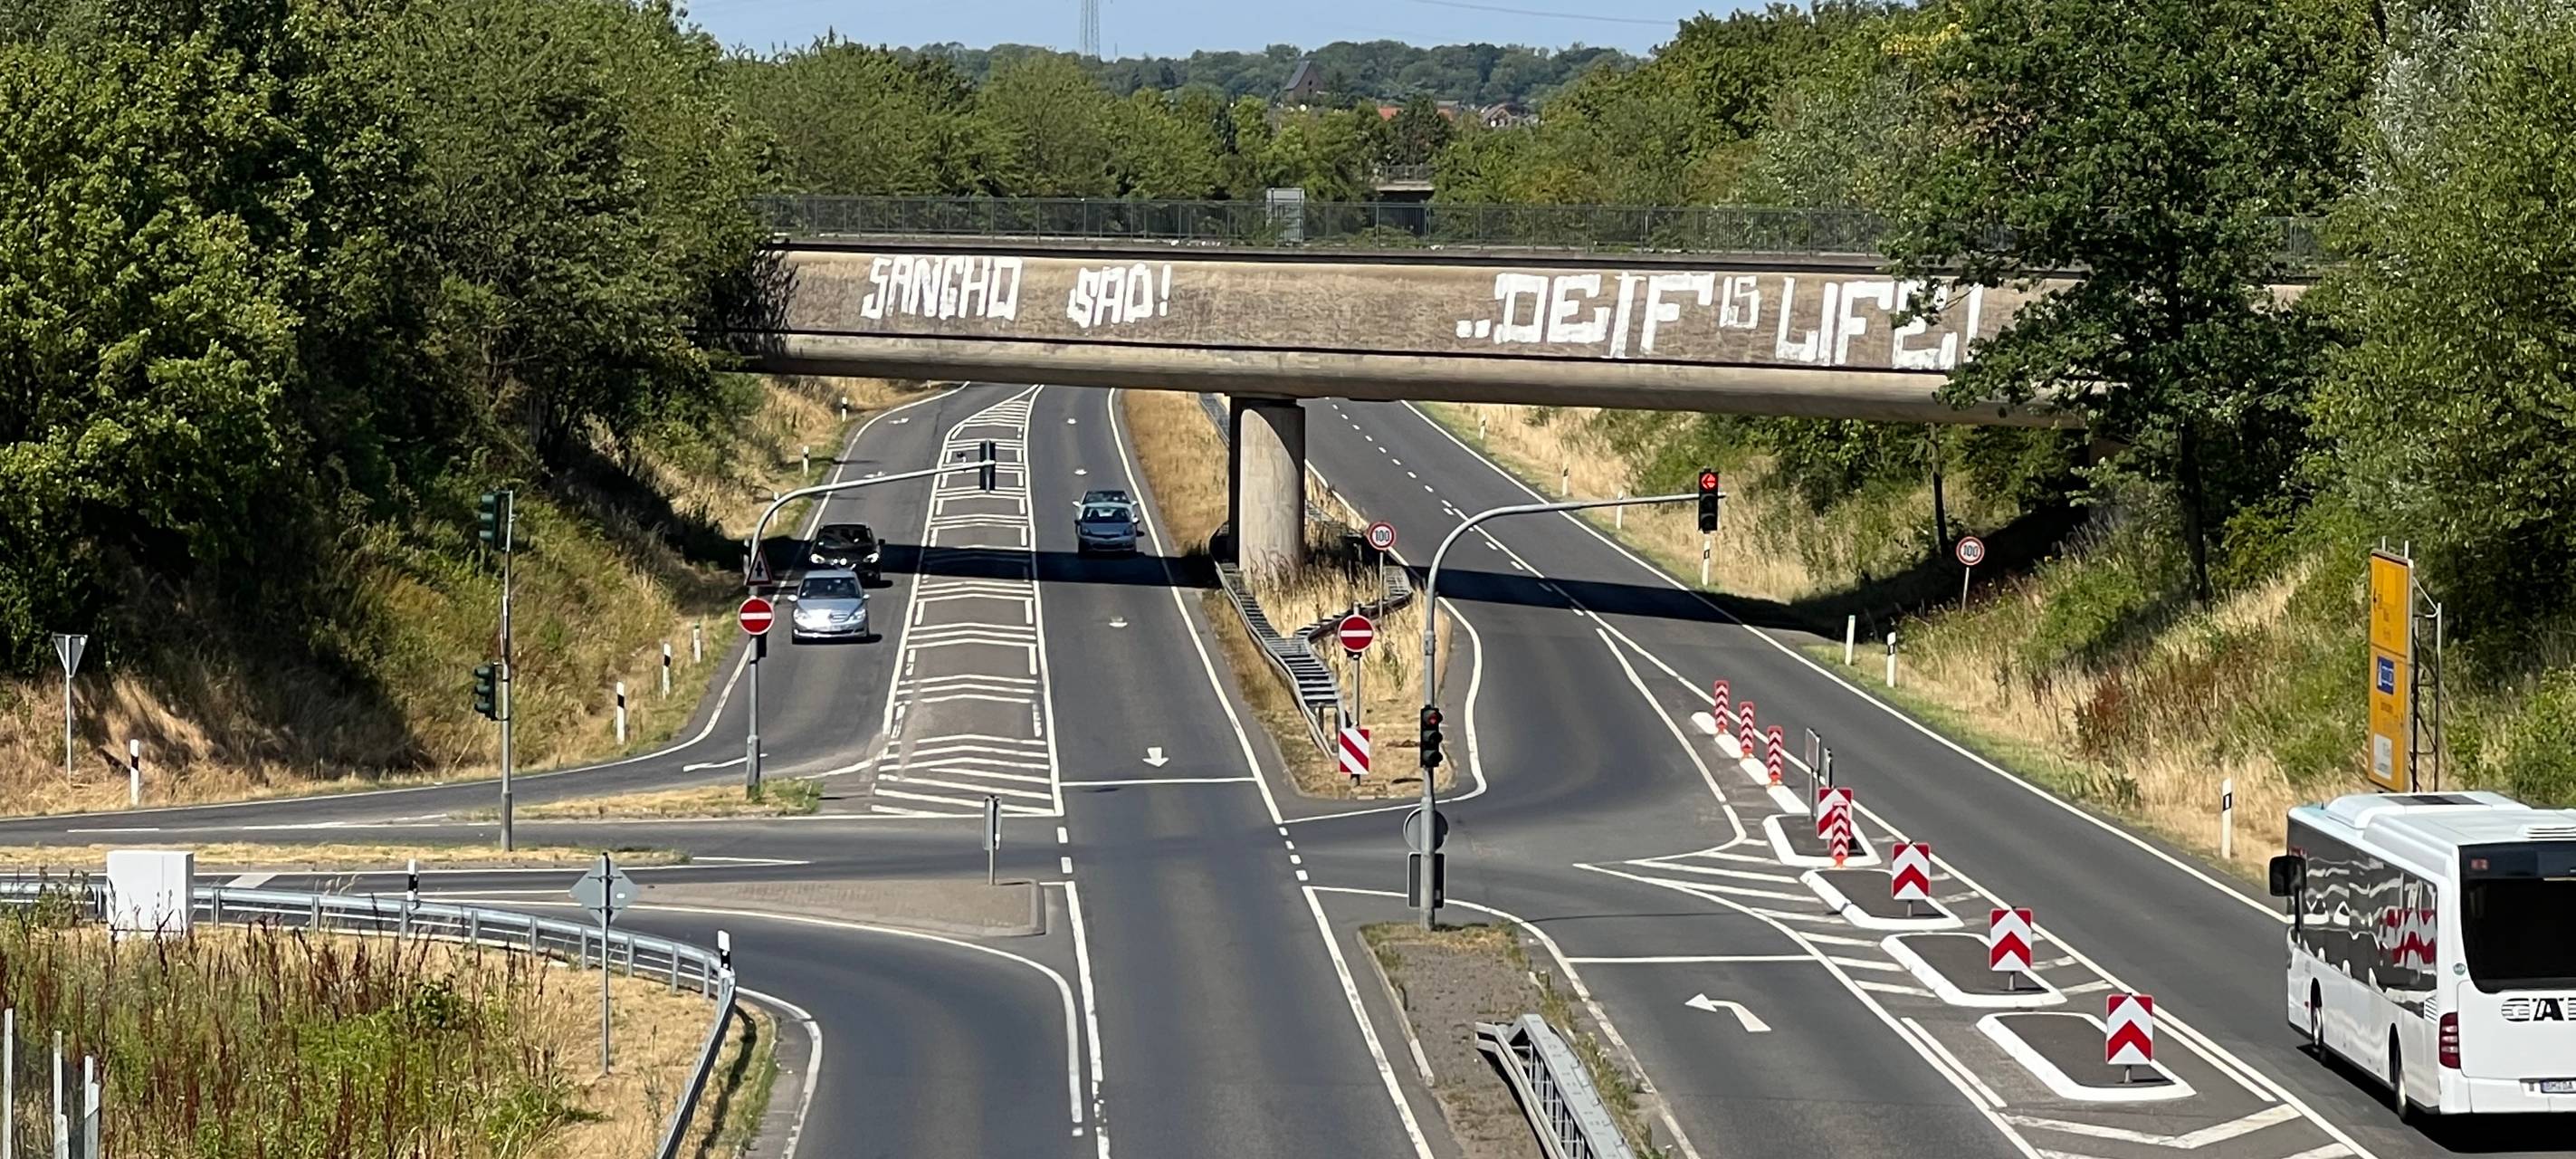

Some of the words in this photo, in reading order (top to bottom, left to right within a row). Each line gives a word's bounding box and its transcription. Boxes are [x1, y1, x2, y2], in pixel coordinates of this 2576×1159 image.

[860, 254, 1022, 321] SANCHO
[1375, 530, 1389, 541] 100
[1963, 545, 1978, 557] 100
